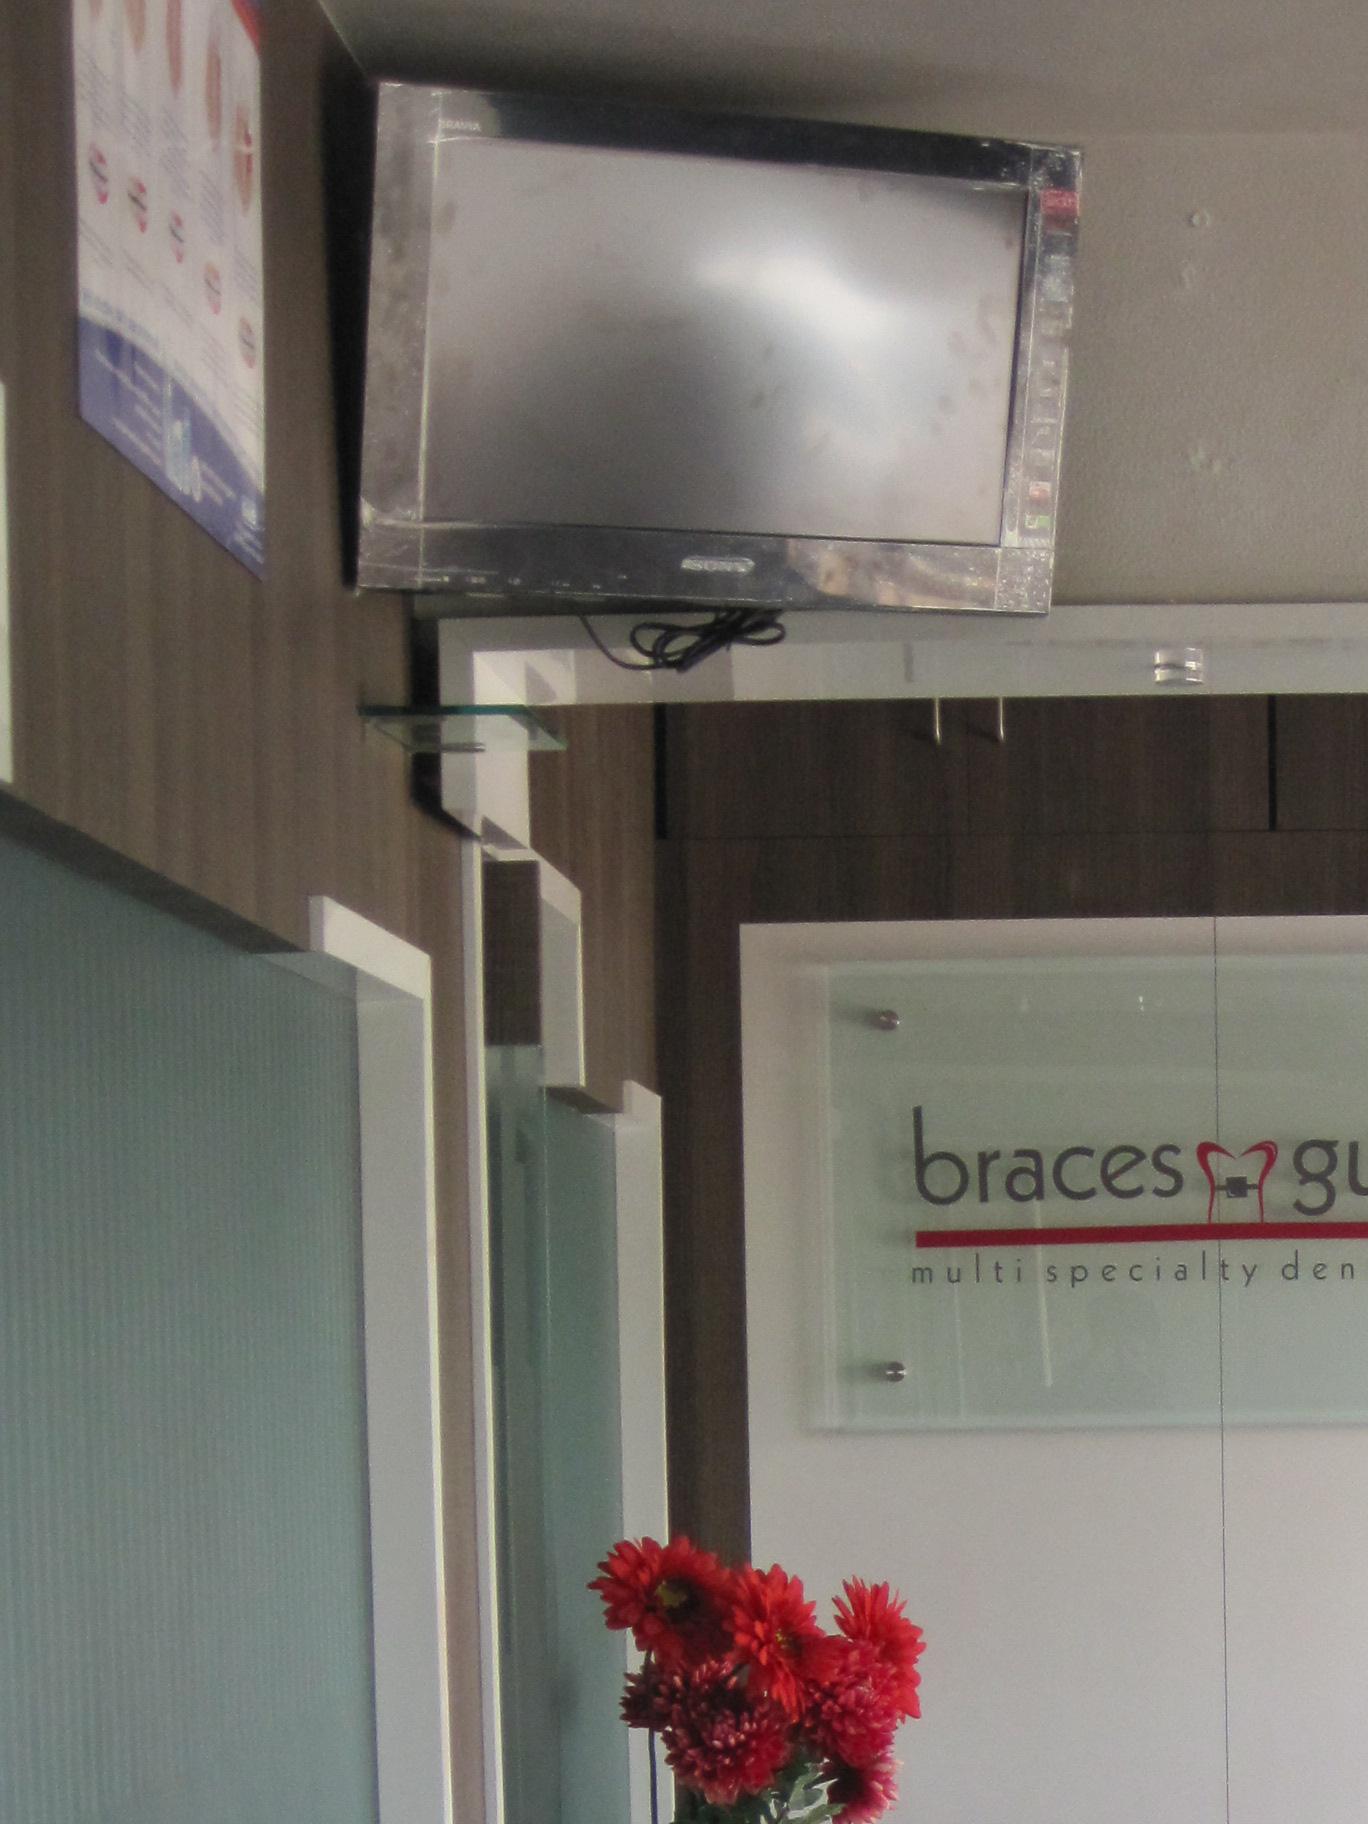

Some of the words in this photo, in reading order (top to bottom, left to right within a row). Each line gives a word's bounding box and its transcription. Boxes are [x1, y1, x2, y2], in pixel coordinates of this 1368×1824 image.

[913, 1105, 1184, 1206] braces
[911, 1253, 1022, 1284] multi
[1046, 1250, 1258, 1288] specialty
